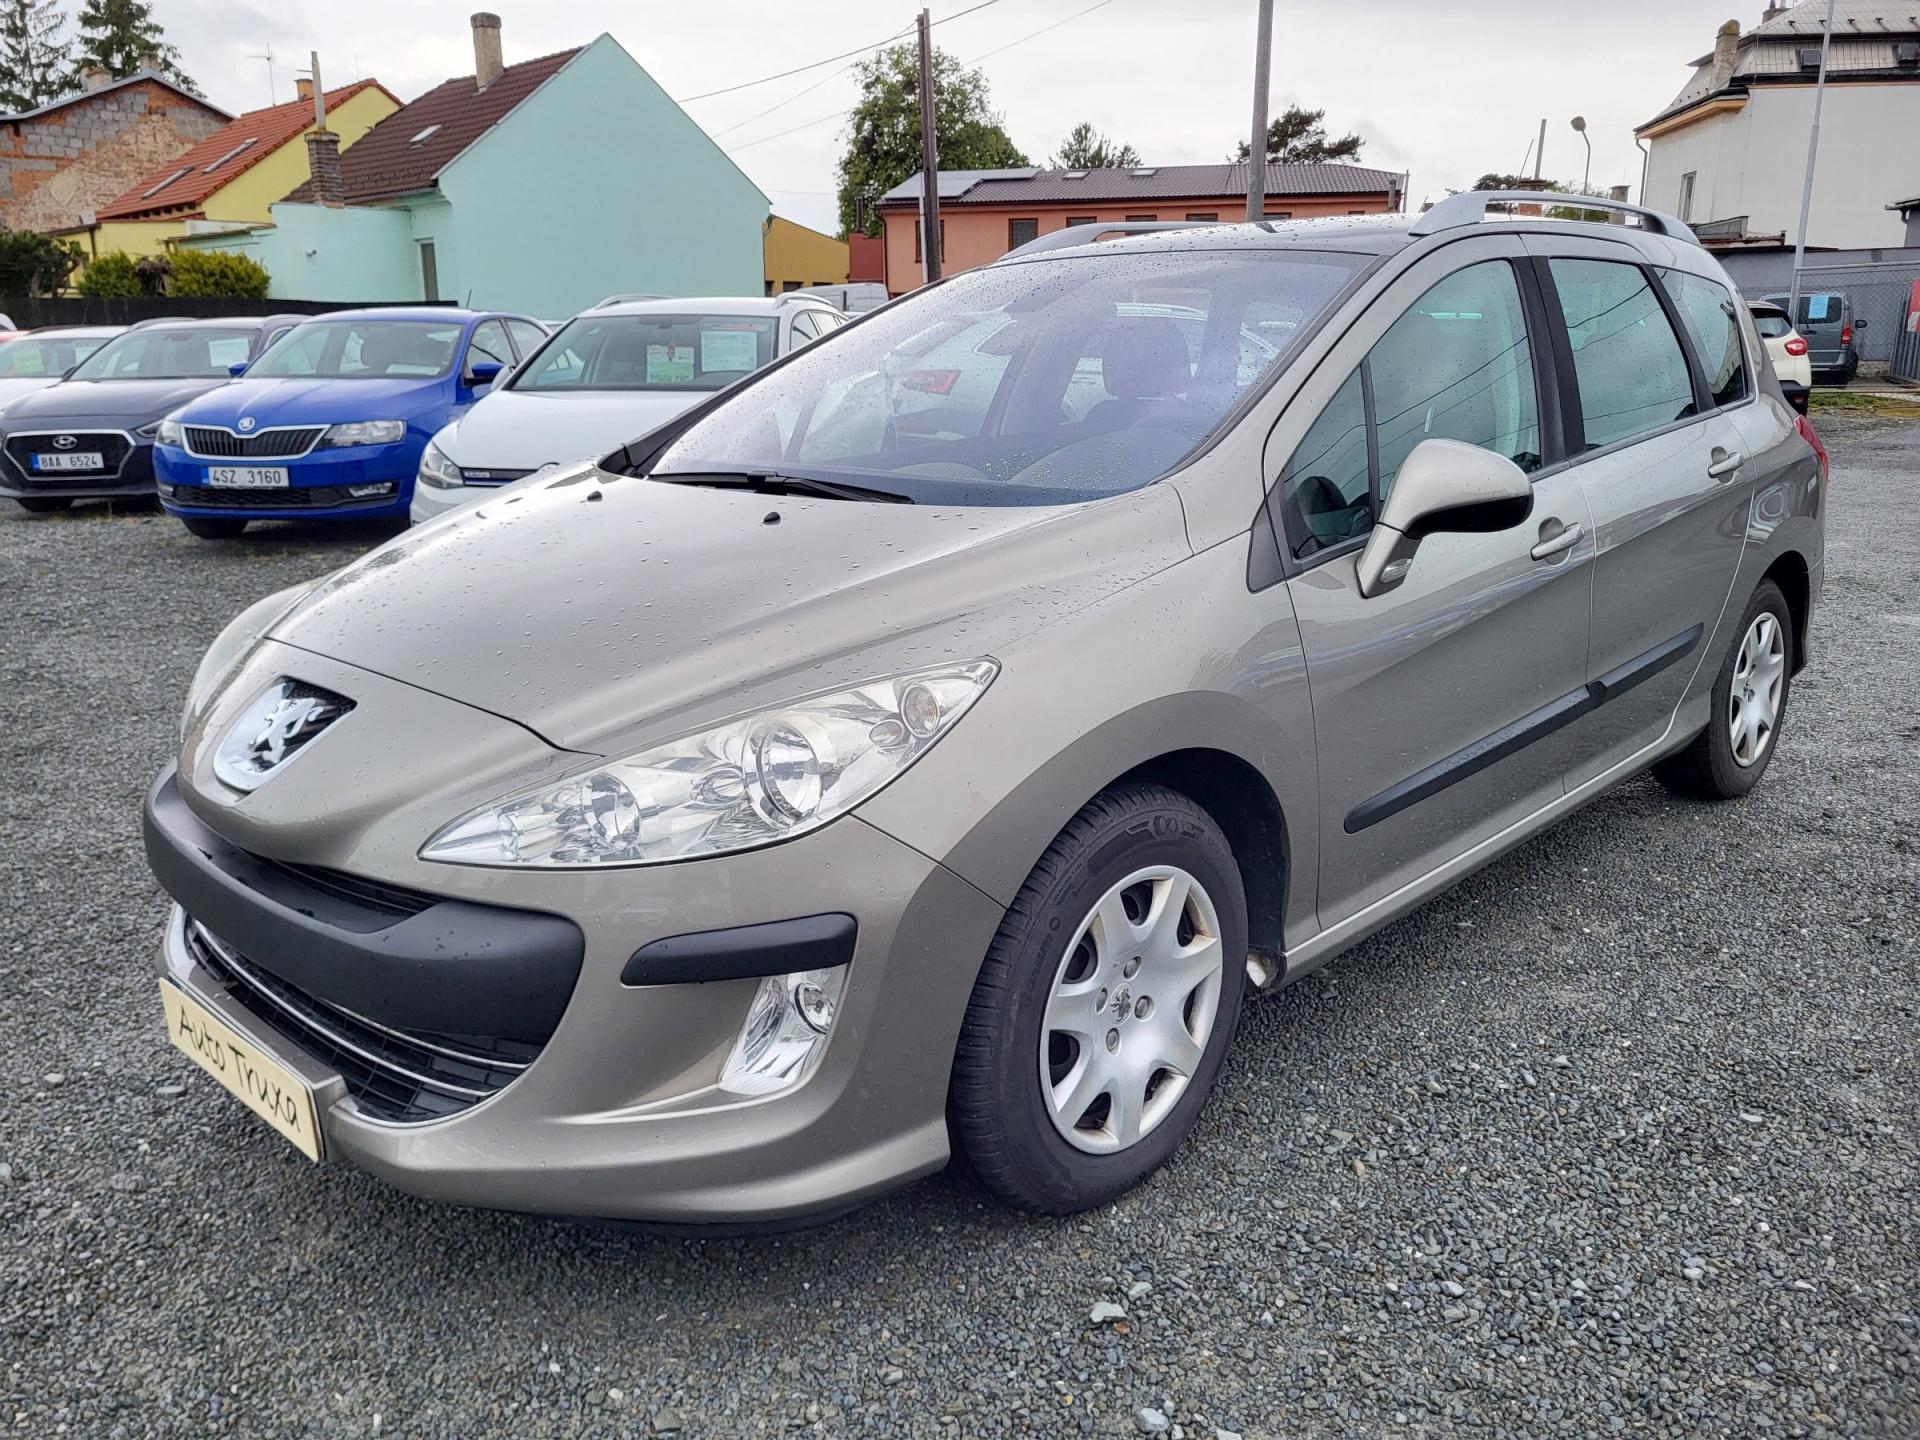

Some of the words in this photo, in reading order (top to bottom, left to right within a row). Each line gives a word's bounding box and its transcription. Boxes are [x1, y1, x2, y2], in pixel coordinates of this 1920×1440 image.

[70, 456, 97, 467] 6524
[213, 469, 237, 484] 4SZ
[247, 470, 281, 484] 3160
[179, 1004, 226, 1072] Auto
[227, 1040, 302, 1134] Truxa
